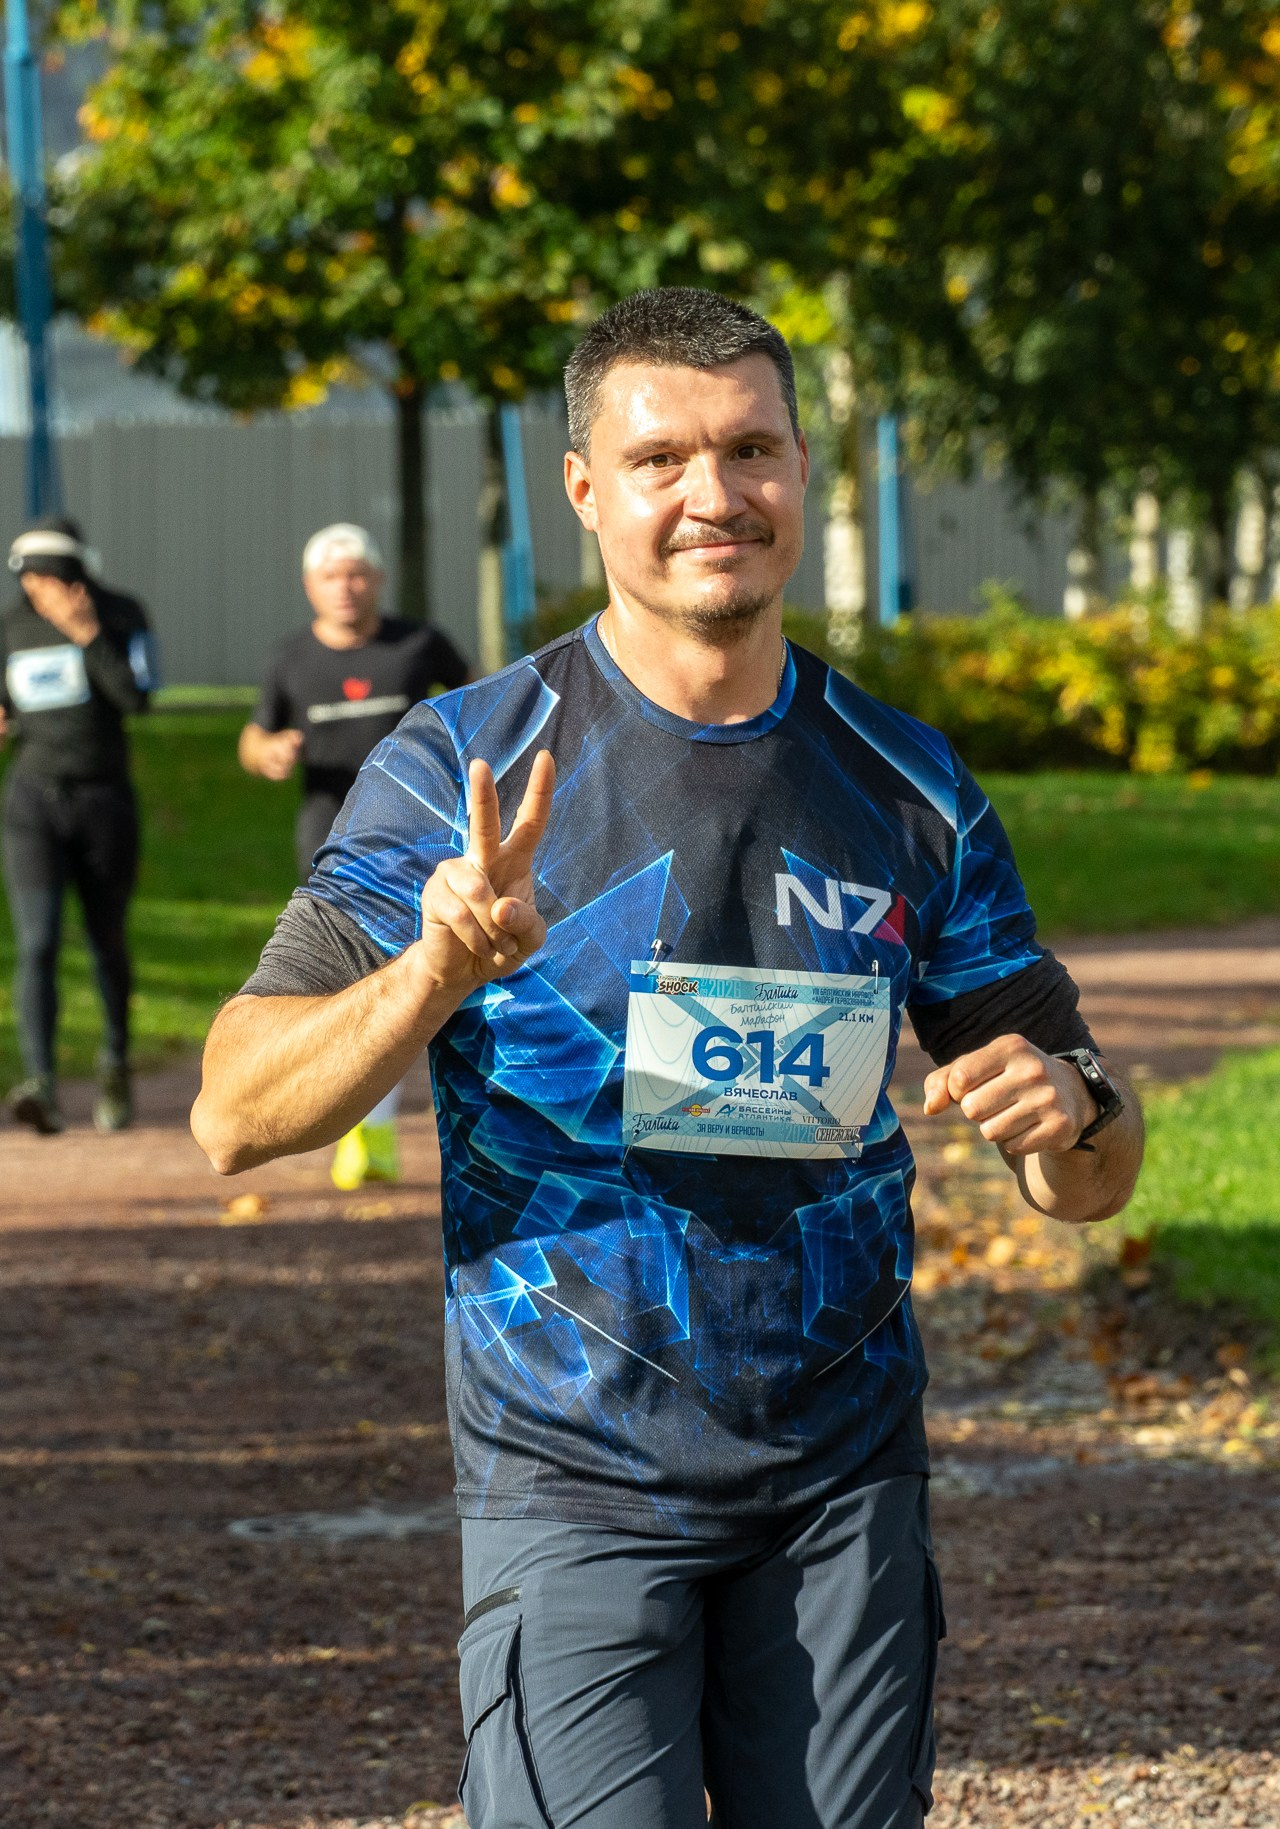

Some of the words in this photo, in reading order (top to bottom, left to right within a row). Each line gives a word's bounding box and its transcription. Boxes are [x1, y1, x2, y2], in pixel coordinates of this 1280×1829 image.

[775, 873, 892, 935] N7
[658, 980, 699, 994] SHOCK
[754, 982, 799, 1001] Балтика
[838, 1012, 856, 1022] 21.1
[692, 1025, 830, 1088] 614
[724, 1087, 798, 1101] ВЯЧЕСЛАВ
[738, 1104, 792, 1116] БАССЕЙНЫ
[632, 1113, 680, 1132] Балтика
[738, 1113, 792, 1123] АТЛАНТИКА
[802, 1115, 841, 1126] VITTORIO
[696, 1123, 707, 1133] ЗА
[707, 1124, 724, 1134] ВЕРУ
[725, 1125, 730, 1135] И
